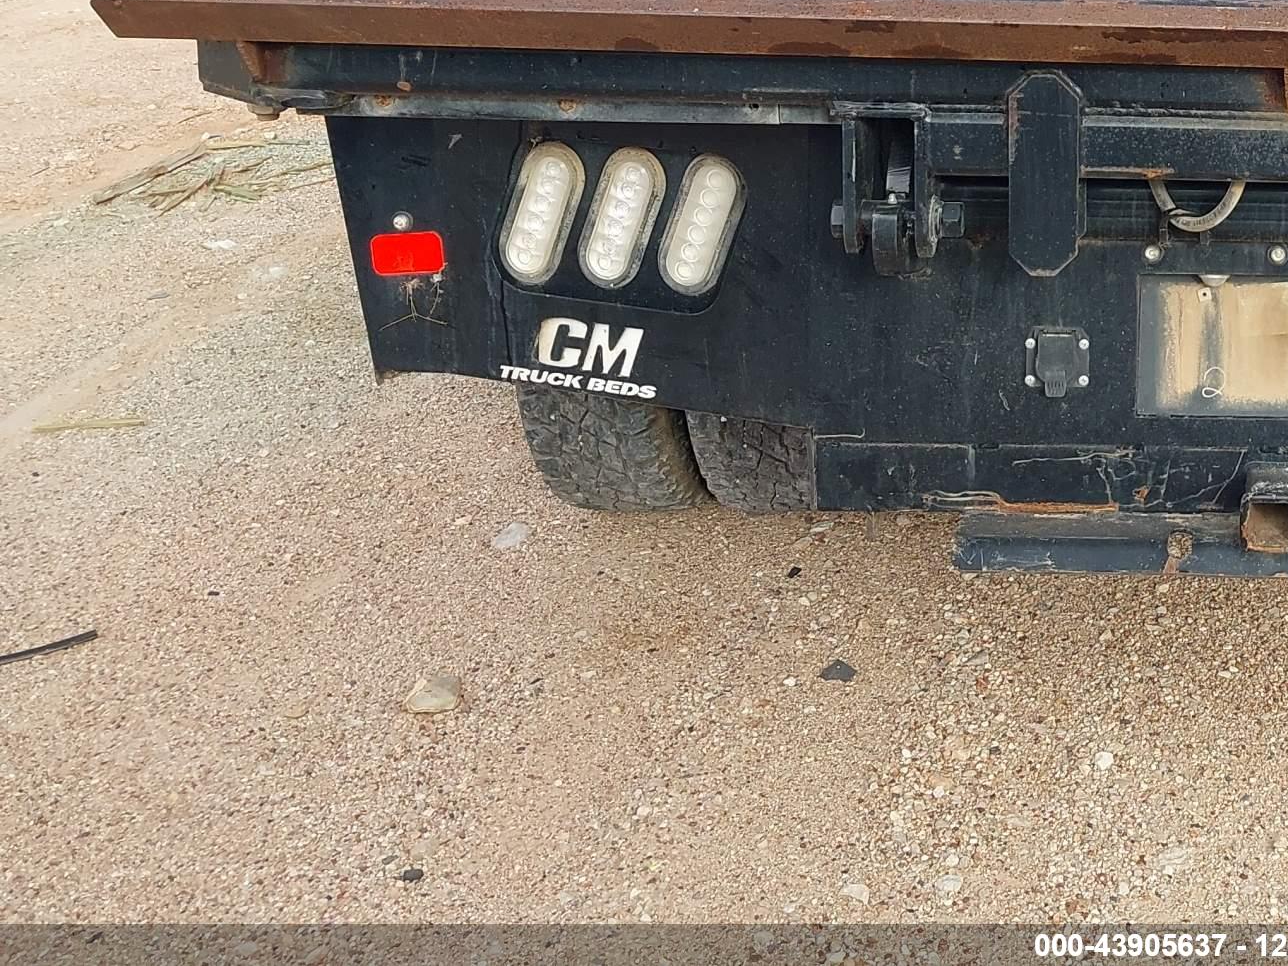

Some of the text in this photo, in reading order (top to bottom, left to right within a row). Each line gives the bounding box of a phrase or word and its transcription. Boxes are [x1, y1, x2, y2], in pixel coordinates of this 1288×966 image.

[537, 316, 645, 379] CM
[499, 365, 658, 400] TRUCK BEDS
